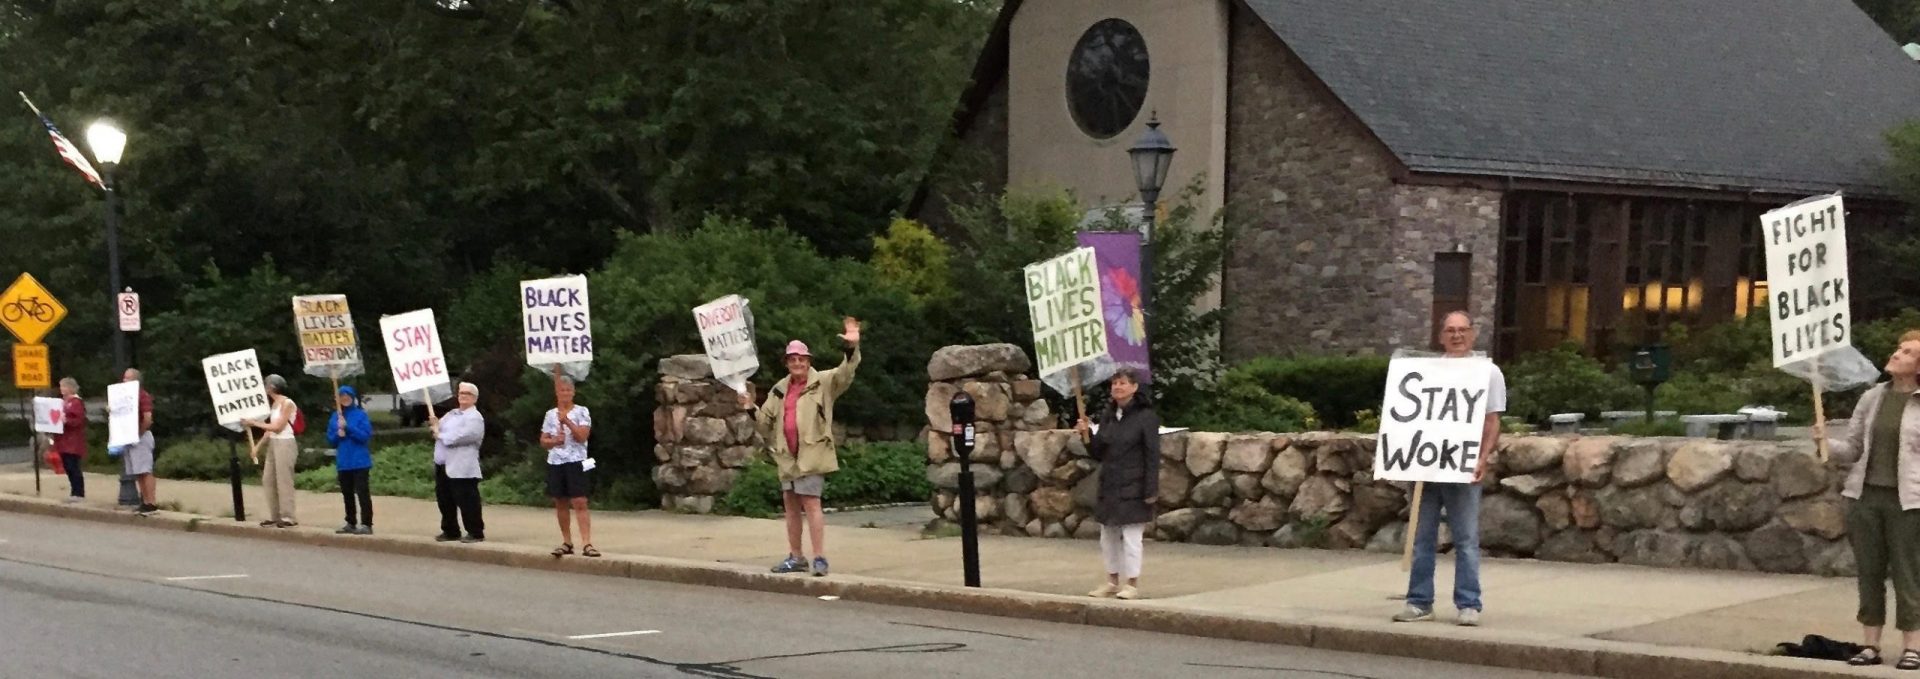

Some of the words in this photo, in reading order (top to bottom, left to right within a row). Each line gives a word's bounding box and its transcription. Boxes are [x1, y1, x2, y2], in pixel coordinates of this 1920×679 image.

[1772, 204, 1836, 245] FIGHT
[1788, 242, 1827, 276] FOR
[1028, 252, 1092, 301] BLACK
[525, 286, 582, 309] BLACK
[1031, 286, 1095, 333] LIVES
[1778, 278, 1845, 320] BLACK
[303, 315, 346, 329] LIVES
[528, 312, 586, 332] LIVES
[1782, 312, 1845, 359] LIVES
[303, 330, 352, 345] MATTER
[393, 324, 431, 353] STAY
[528, 334, 592, 355] MATTER
[1036, 318, 1104, 370] MATTER
[210, 358, 255, 377] BLACK
[395, 358, 442, 382] WOKE
[217, 375, 259, 393] LIVES
[1390, 371, 1485, 423] STAY
[218, 393, 265, 415] MATTER
[1382, 430, 1480, 473] WOKE
